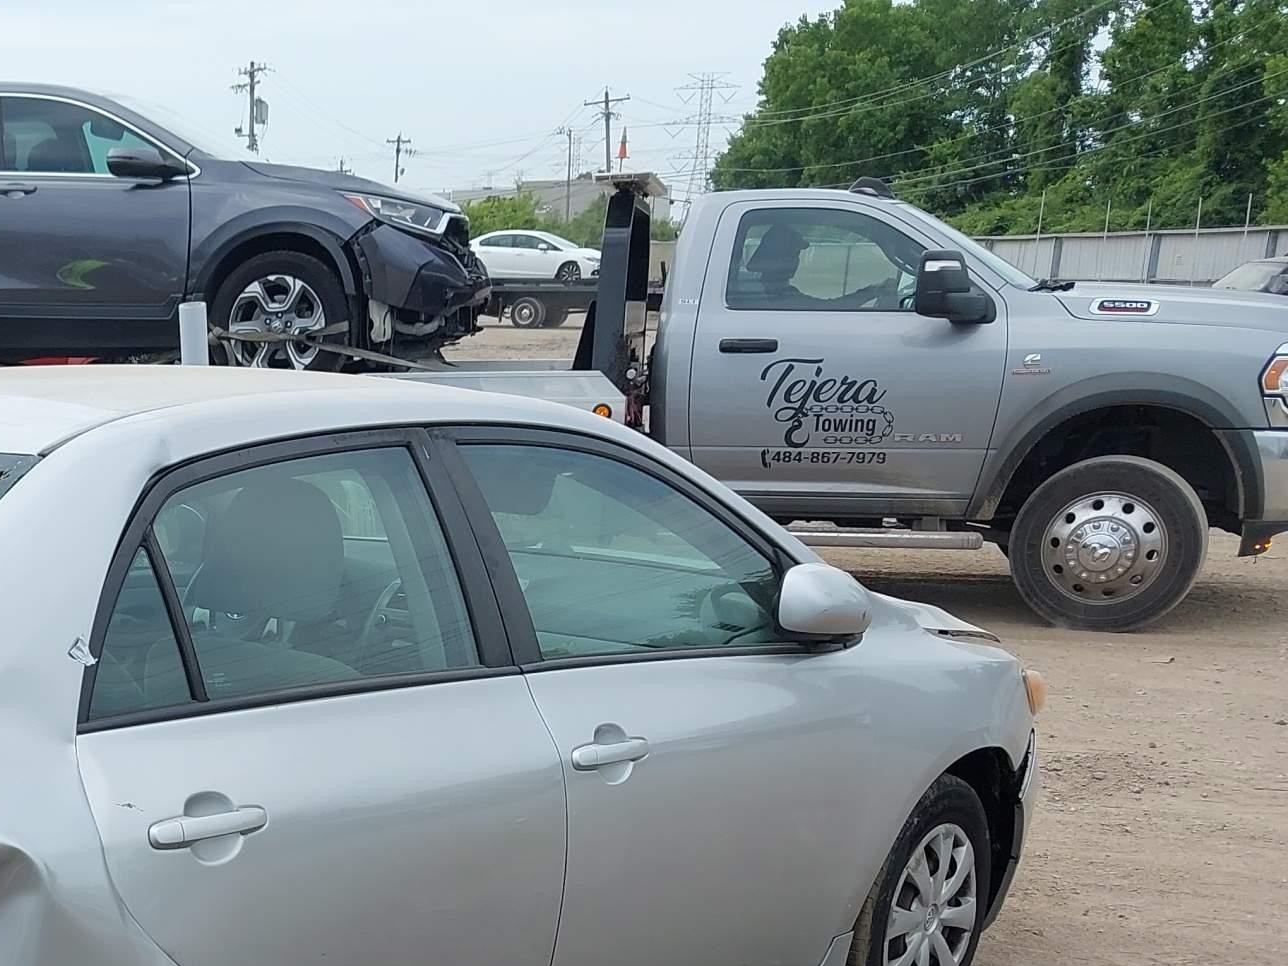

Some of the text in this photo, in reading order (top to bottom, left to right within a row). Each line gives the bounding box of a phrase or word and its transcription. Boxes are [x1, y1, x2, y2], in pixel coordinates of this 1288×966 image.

[760, 358, 888, 422] Tejera
[814, 413, 877, 436] Towing
[894, 432, 962, 442] RAM
[771, 451, 886, 464] 484-867-7979
